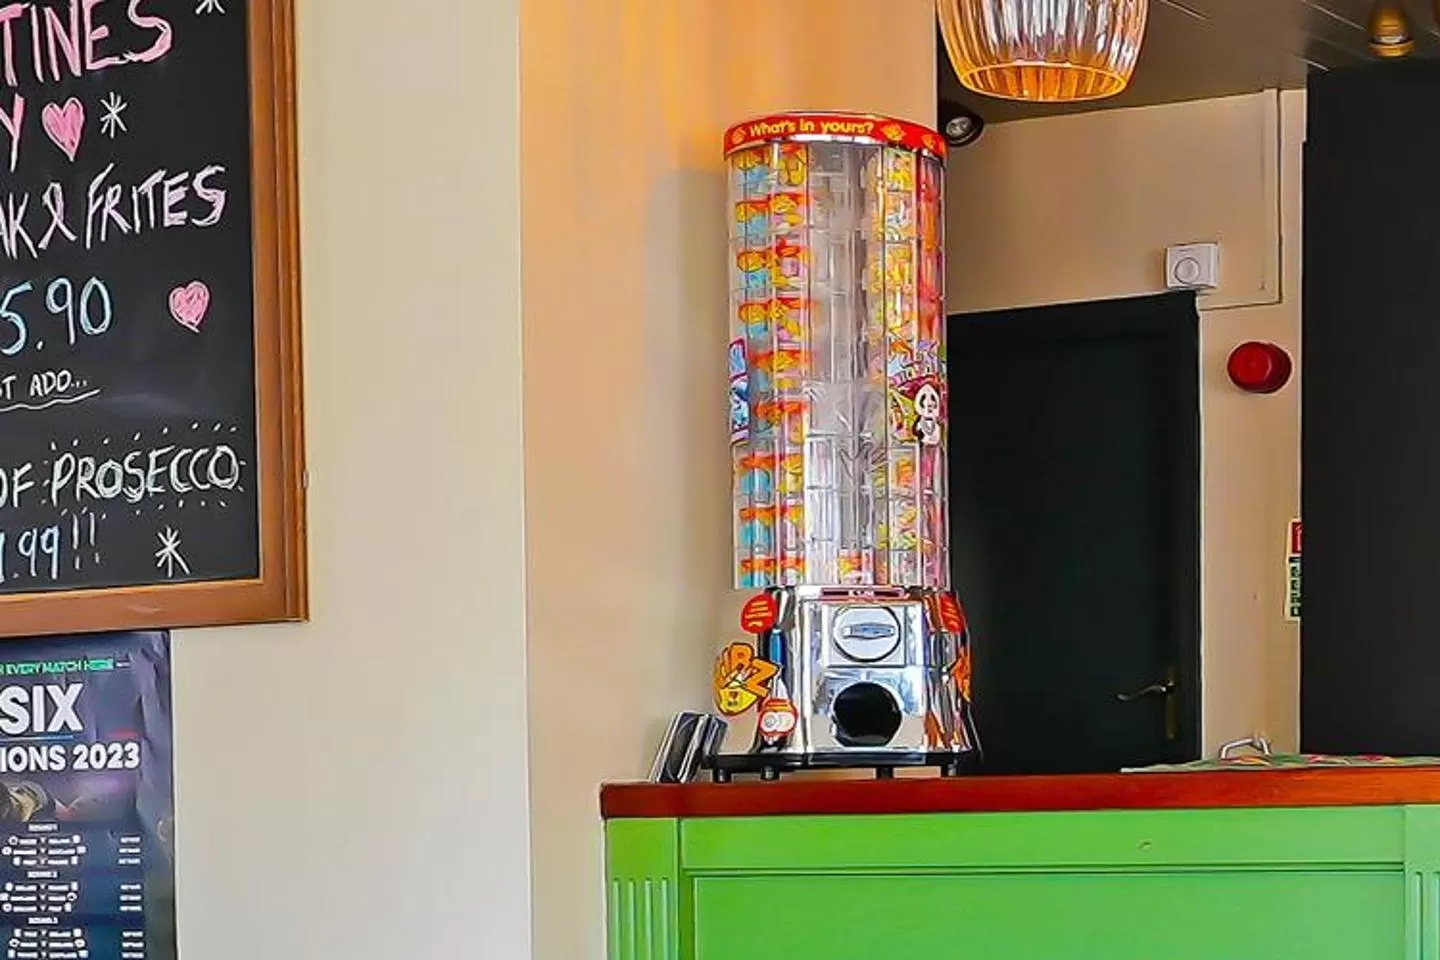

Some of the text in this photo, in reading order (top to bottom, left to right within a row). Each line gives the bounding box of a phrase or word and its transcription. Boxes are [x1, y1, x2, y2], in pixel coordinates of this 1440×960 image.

[750, 119, 874, 137] What's in yours?
[86, 163, 226, 249] FRITES
[52, 444, 240, 508] PROSECCO
[0, 683, 84, 735] SIX
[0, 742, 140, 773] IONS 2023
